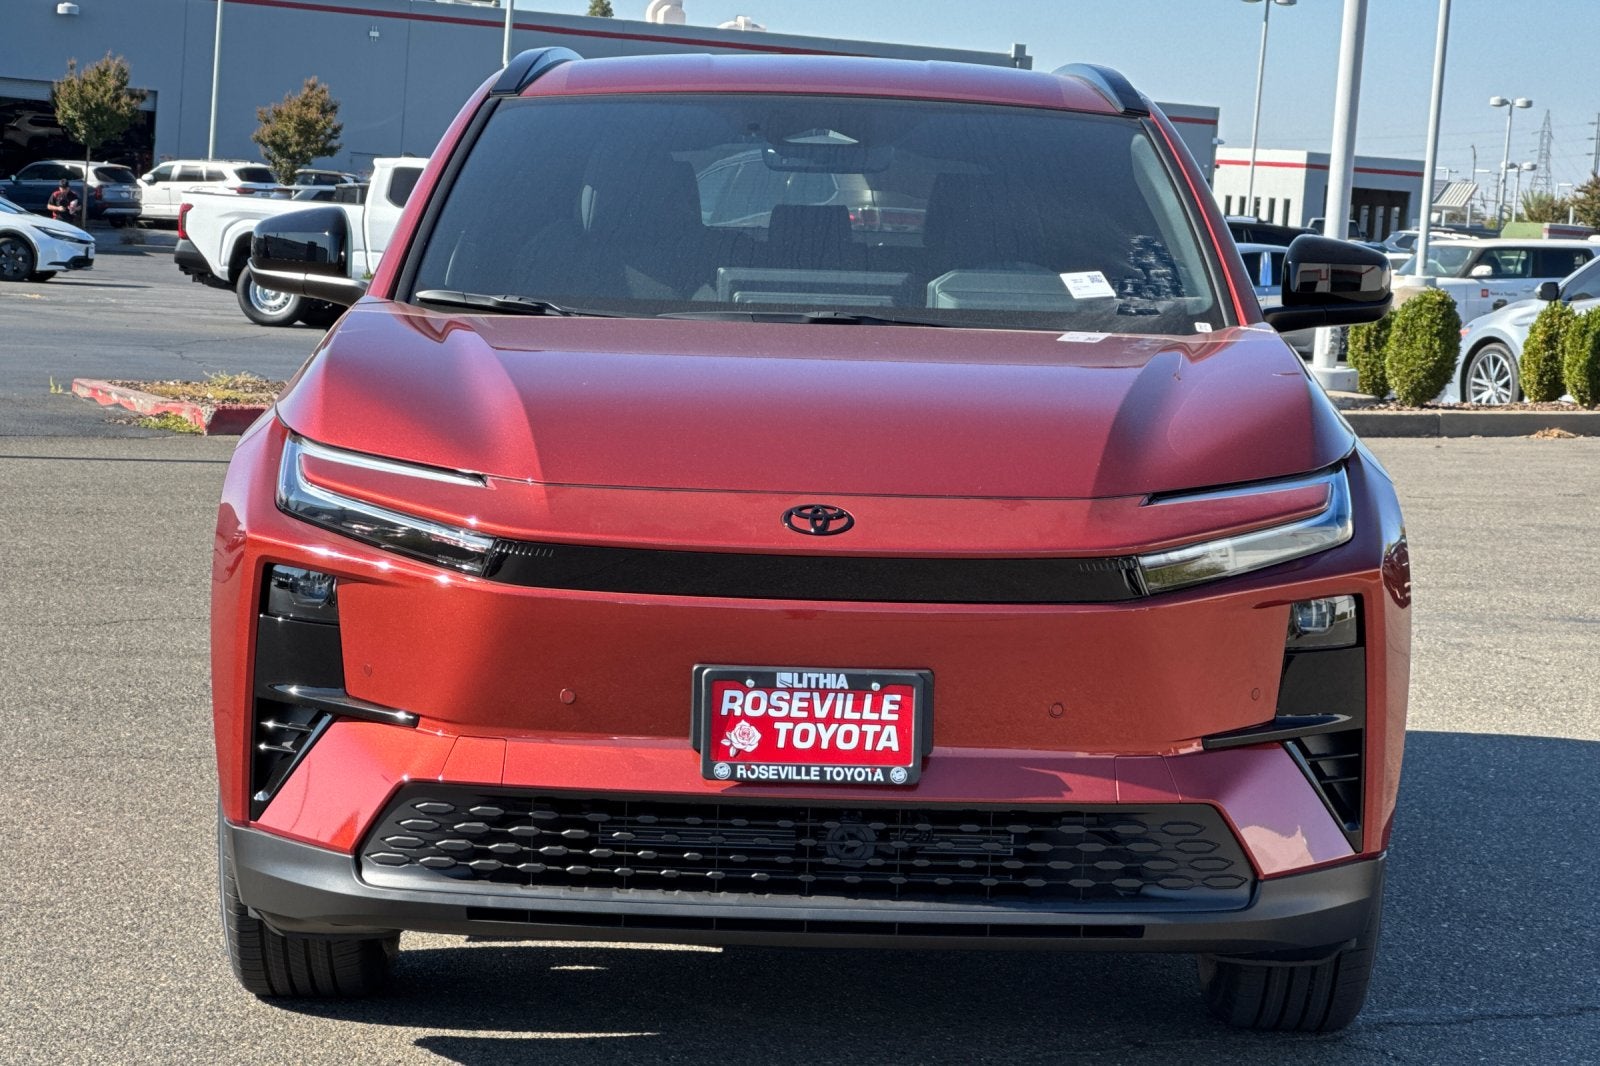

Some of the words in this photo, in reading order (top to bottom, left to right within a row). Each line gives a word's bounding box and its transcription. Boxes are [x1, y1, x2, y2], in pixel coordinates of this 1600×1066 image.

[793, 672, 849, 690] LITHIA
[720, 689, 902, 721] ROSEVILLE
[773, 721, 900, 752] TOYOTA
[736, 764, 820, 780] ROSEVILLE
[823, 766, 884, 782] TOYOTA
